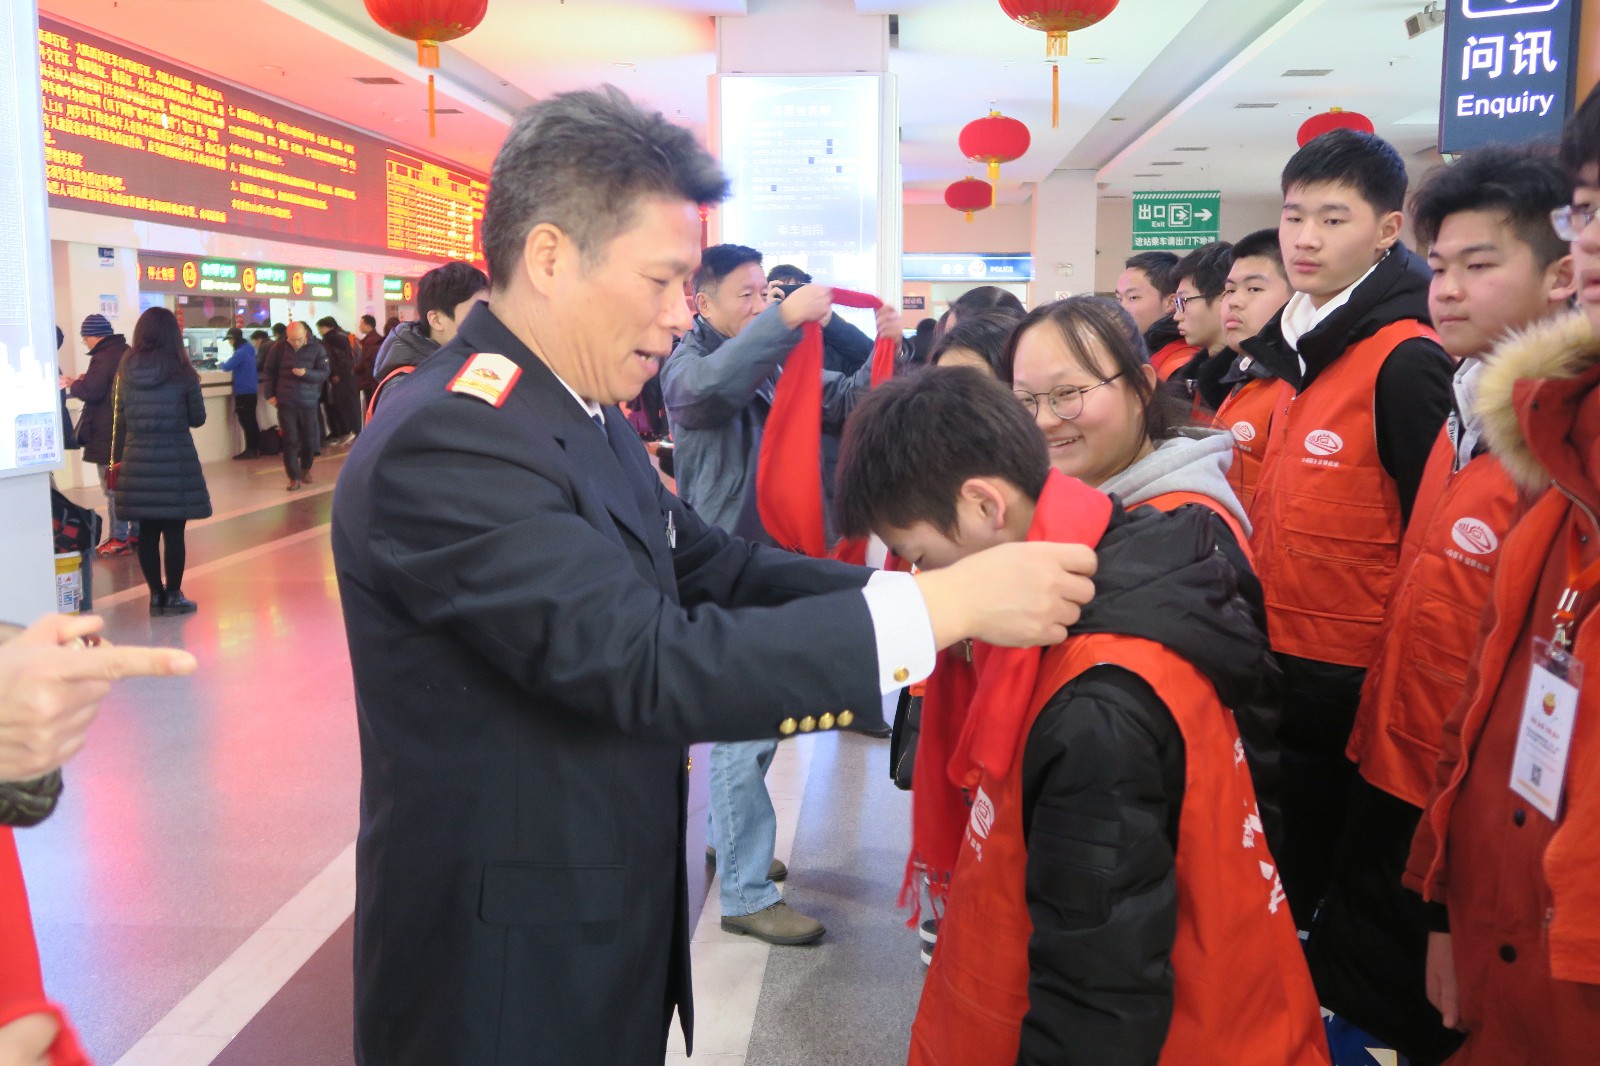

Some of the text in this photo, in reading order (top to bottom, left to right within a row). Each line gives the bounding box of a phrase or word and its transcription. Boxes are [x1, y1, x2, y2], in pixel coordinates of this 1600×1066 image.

[1461, 30, 1557, 80] 问讯
[1457, 91, 1554, 119] Enquiry
[1138, 204, 1166, 220] 出口
